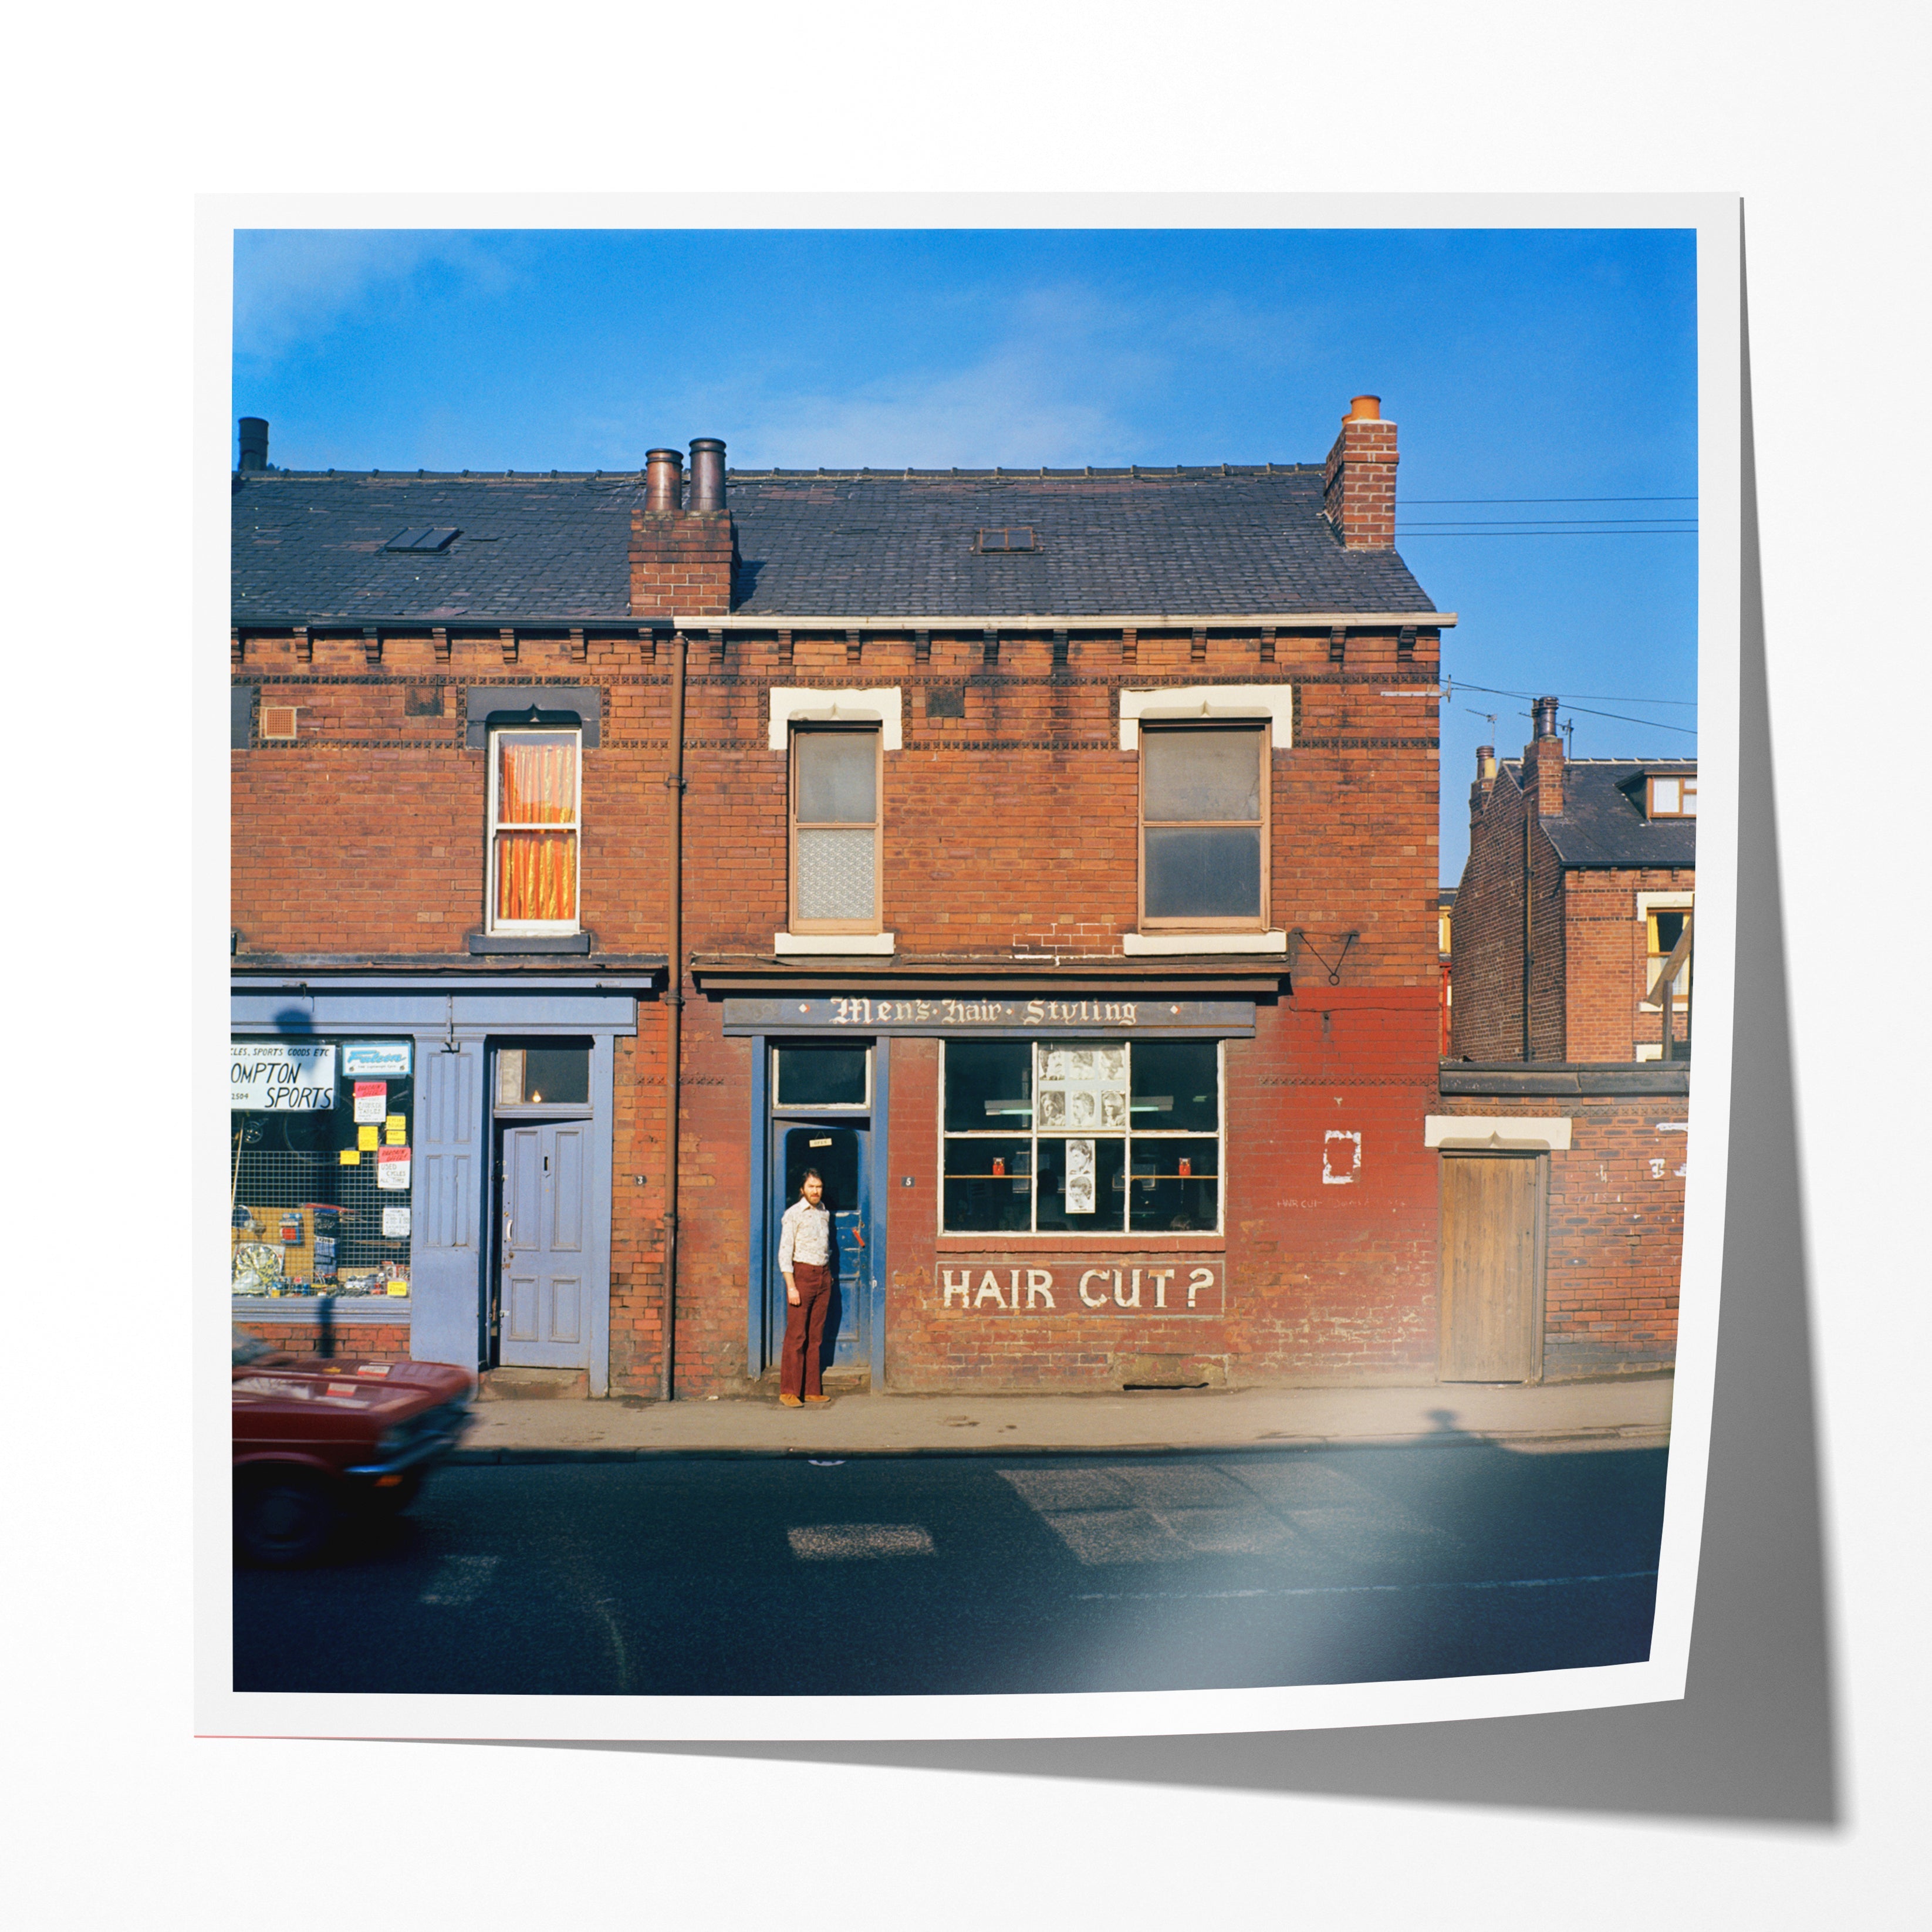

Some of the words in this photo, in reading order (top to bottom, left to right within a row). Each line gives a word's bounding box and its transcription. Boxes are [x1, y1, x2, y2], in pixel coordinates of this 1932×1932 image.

[829, 997, 931, 1025] Men's
[1021, 998, 1138, 1025] Styling
[253, 1048, 283, 1056] SPORTS
[347, 1050, 407, 1063] Falcon
[264, 1087, 333, 1108] SPORTS
[637, 1176, 643, 1184] 3
[942, 1269, 1056, 1309] HAIR
